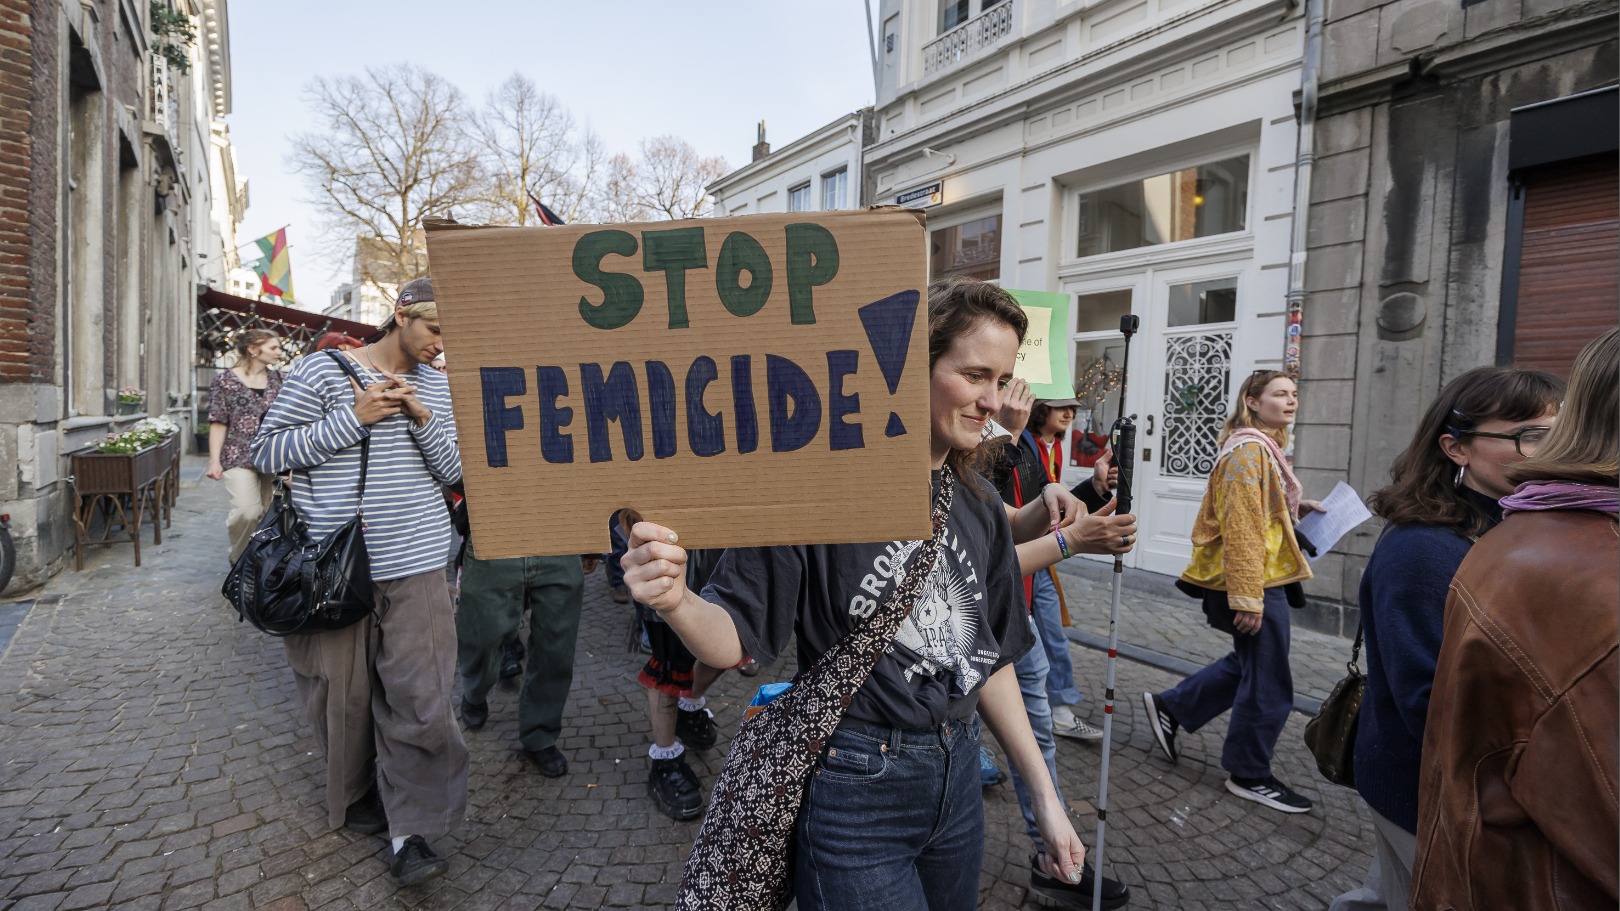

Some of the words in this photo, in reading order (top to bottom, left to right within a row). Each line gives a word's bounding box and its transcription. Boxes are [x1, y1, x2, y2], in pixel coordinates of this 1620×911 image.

[900, 186, 937, 203] Bredestraat
[571, 222, 840, 330] STOP
[1034, 338, 1042, 346] of
[479, 289, 920, 468] FEMICIDE!
